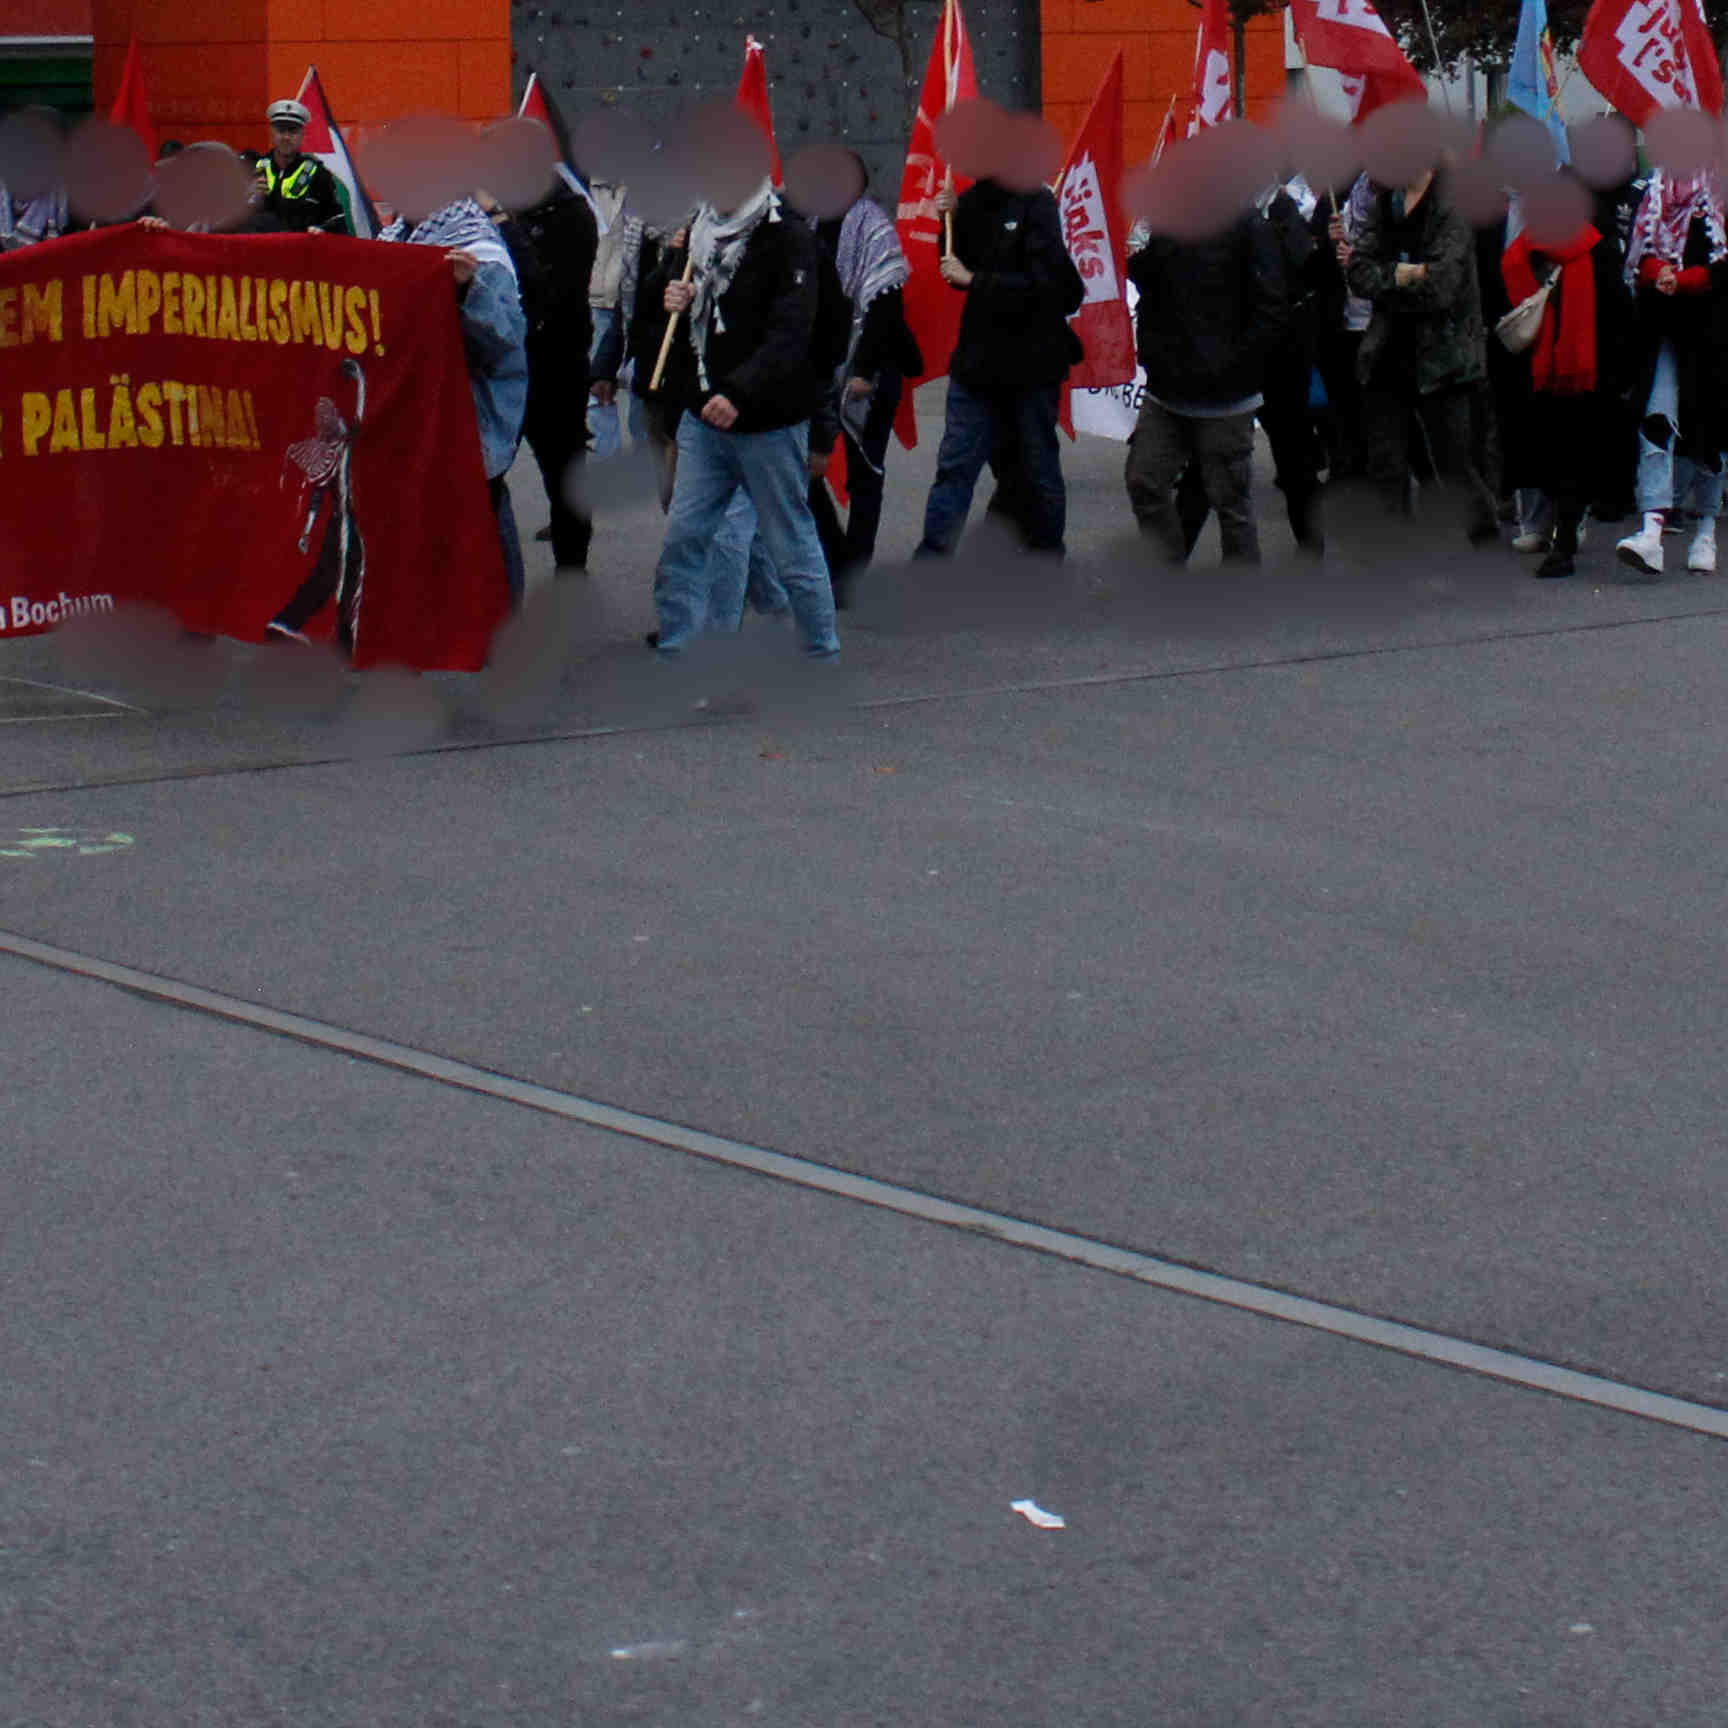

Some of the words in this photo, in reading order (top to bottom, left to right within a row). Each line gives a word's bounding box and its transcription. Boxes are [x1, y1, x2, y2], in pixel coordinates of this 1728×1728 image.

[81, 268, 387, 359] IMPERIALISMUS!
[21, 371, 263, 457] PALÄSTINA!
[9, 591, 115, 629] Bochum
